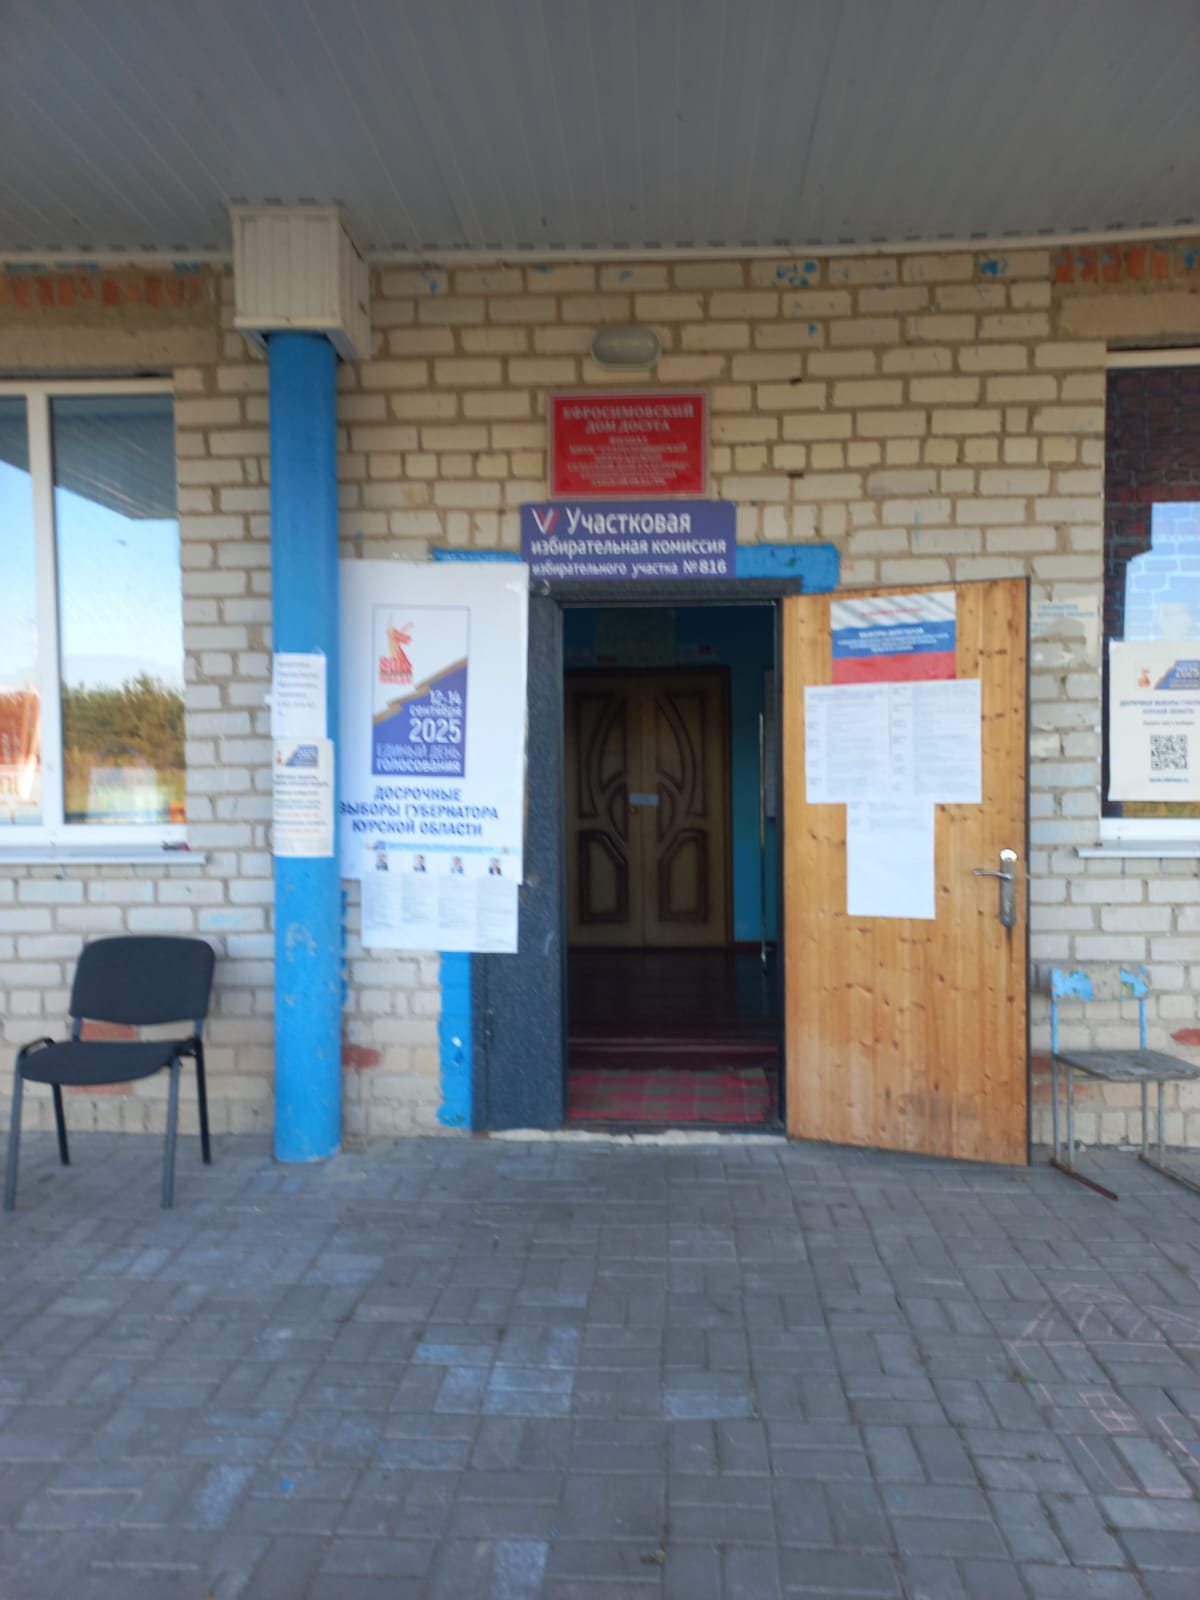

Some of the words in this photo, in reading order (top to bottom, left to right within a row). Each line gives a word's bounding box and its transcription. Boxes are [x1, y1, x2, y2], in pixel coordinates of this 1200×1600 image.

[563, 404, 694, 419] ЕФРОСИМОВСКИЙ
[585, 420, 616, 434] ДОМ
[619, 419, 671, 433] ДОСУГА
[566, 507, 692, 535] Участковая
[531, 536, 648, 560] избирательная
[651, 538, 727, 554] комиссия
[531, 561, 628, 579] избирательного
[631, 561, 679, 579] участка
[408, 717, 462, 744] 2025
[374, 785, 463, 801] ДОСРОЧНЫЕ
[404, 802, 500, 820] ГУБЕРНАТОРА
[352, 817, 416, 834] КУРСКОЙ
[419, 821, 484, 837] ОБЛАСТИ
